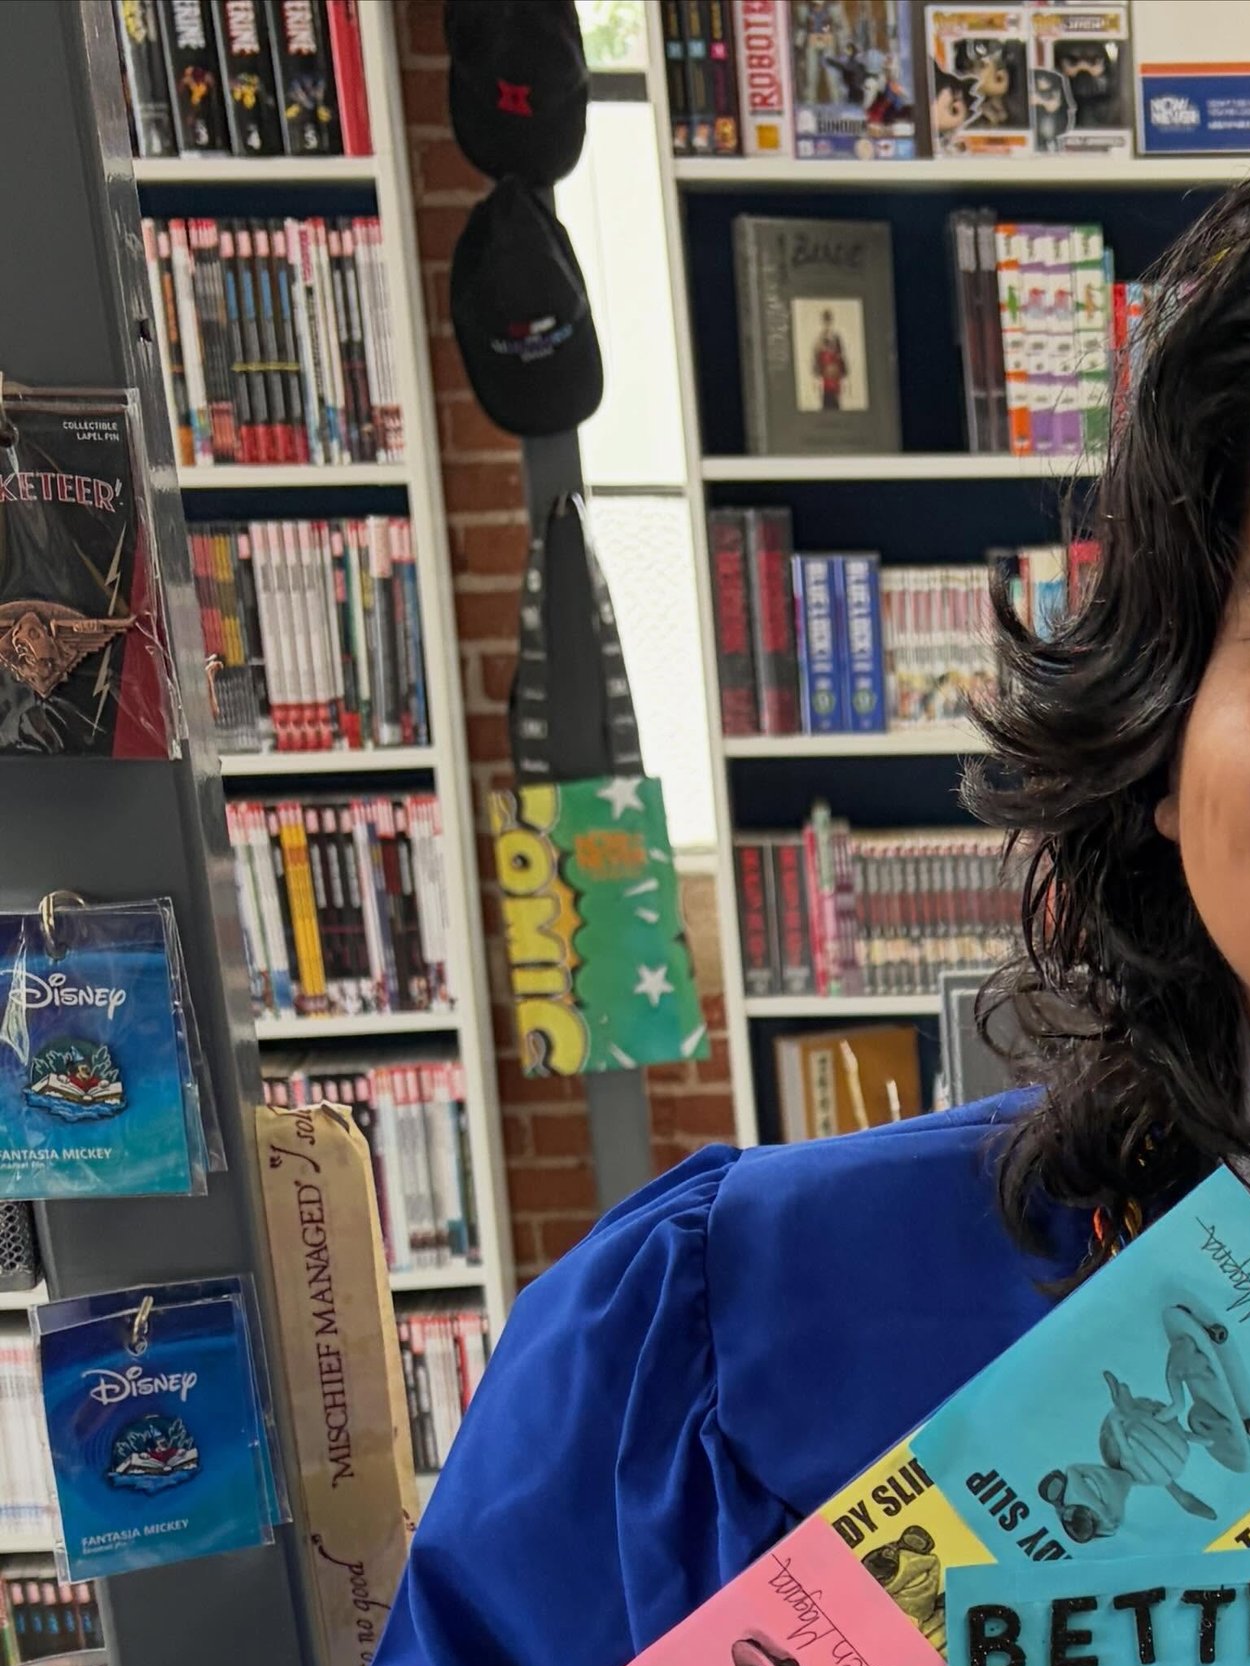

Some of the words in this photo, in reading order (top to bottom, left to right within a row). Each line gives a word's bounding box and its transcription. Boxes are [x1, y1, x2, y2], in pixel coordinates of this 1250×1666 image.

[62, 421, 118, 431] COLLECTIBLE
[77, 432, 103, 441] LAPEL
[105, 433, 120, 442] PIN
[0, 1148, 59, 1161] ANTASIA
[62, 1146, 113, 1159] MICKEY
[965, 1470, 1031, 1532] SLIP
[81, 1527, 141, 1547] FANTASIA
[144, 1518, 189, 1536] MICKEY
